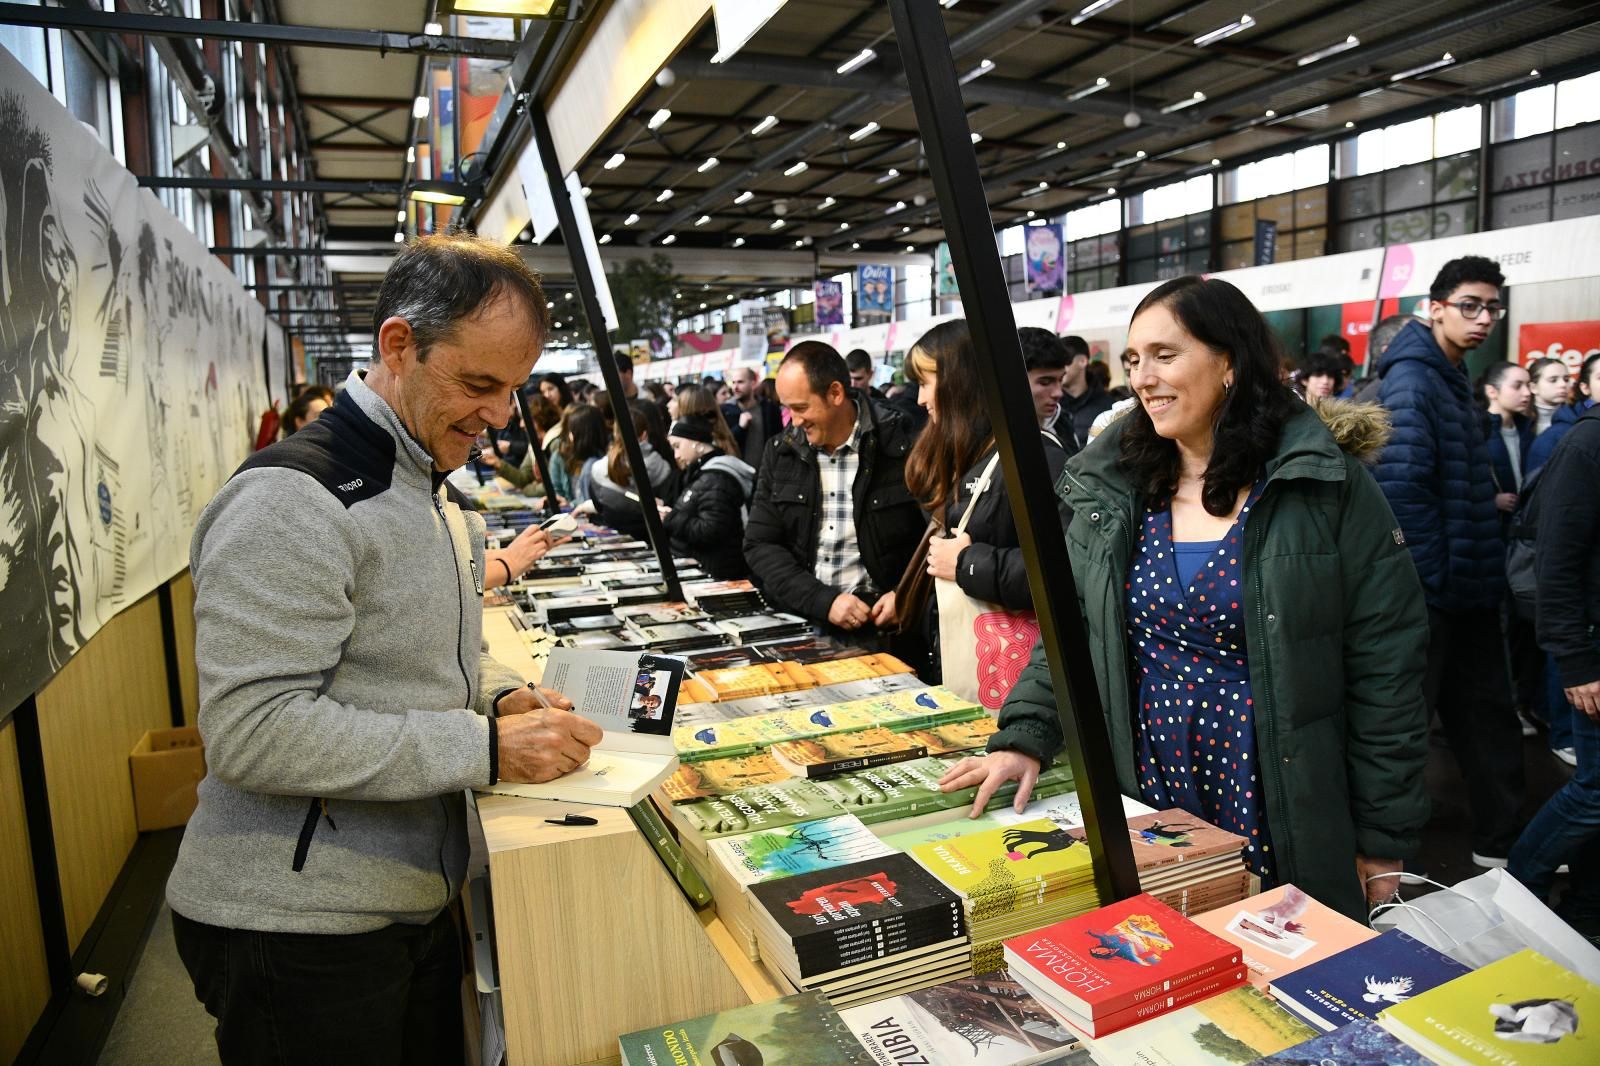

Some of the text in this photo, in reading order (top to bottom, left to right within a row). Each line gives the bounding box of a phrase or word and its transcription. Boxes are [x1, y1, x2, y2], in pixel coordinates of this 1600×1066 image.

[1525, 342, 1600, 375] afe
[1041, 937, 1083, 967] HAUSHOFER
[1026, 940, 1106, 993] HORMA
[1081, 965, 1112, 986] MARLEN
[1133, 985, 1162, 1000] HORMA
[1305, 989, 1340, 1012] distira
[1136, 1002, 1165, 1017] HORMA
[870, 1015, 932, 1066] ZUBIA
